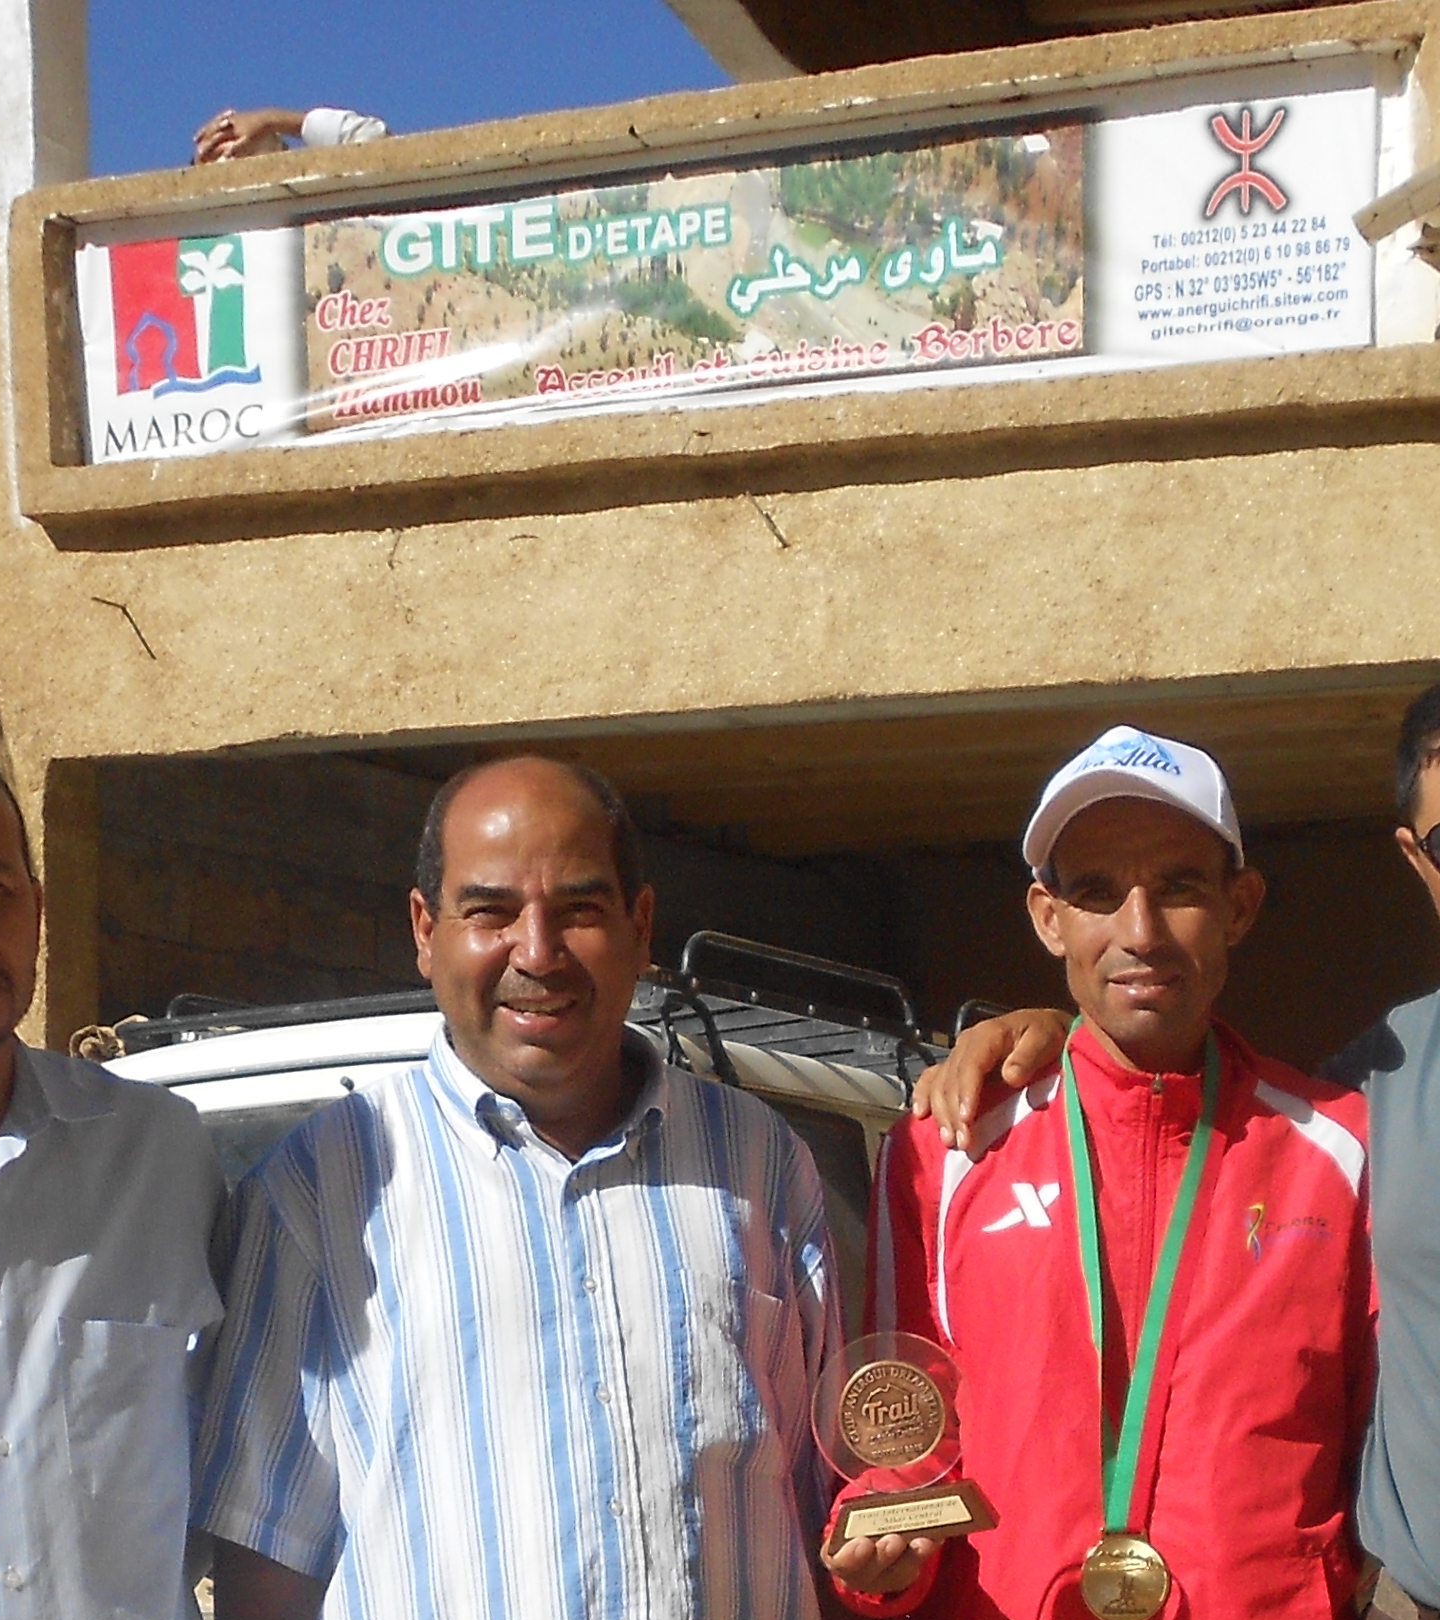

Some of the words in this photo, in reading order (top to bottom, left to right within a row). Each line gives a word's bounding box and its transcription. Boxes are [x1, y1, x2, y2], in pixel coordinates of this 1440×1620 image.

[383, 204, 554, 275] GITE
[568, 206, 727, 260] D'ETAPE
[883, 220, 998, 287] مأوى
[1181, 226, 1236, 247] 00212(0)
[1240, 225, 1249, 240] 5
[1252, 222, 1268, 239] 23
[1271, 220, 1287, 236] 44
[1292, 218, 1307, 234] 22
[1311, 216, 1327, 232] 84
[1204, 249, 1260, 267] 00212(0)
[1264, 245, 1272, 261] 6
[1277, 243, 1292, 259] 10
[1296, 241, 1311, 257] 98
[1315, 239, 1331, 255] 86
[1335, 236, 1351, 252] 79
[731, 249, 861, 313] مرحلي
[1134, 281, 1164, 302] GPS
[1175, 280, 1185, 298] N
[316, 290, 391, 331] Chez
[1150, 308, 1342, 341] gitechrifi@orange.fr
[329, 328, 451, 377] CHRIFI
[693, 347, 731, 384] et
[748, 336, 889, 377] cuisine
[911, 315, 1079, 363] Berbere
[104, 403, 264, 457] MAROC
[861, 1393, 920, 1426] Trail
